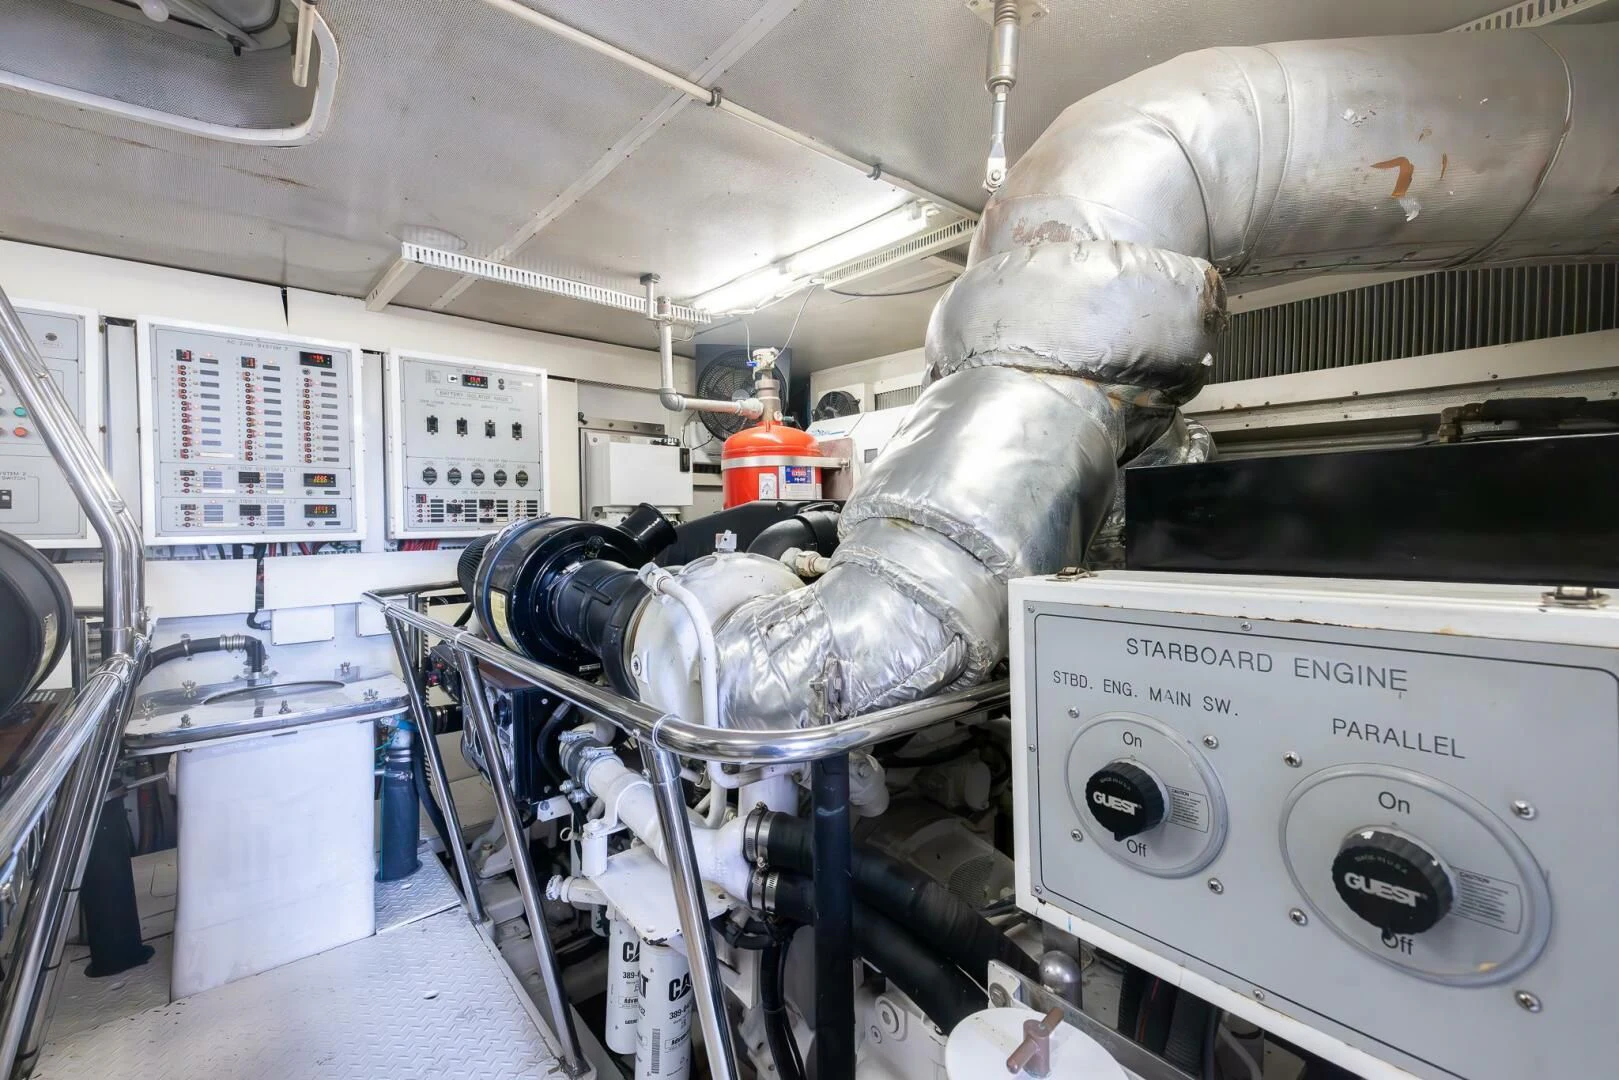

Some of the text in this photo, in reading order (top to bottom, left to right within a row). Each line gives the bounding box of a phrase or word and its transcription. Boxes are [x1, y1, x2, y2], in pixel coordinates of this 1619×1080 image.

[1126, 637, 1408, 692] STARBOARD ENGINE
[1053, 670, 1238, 716] STBD. ENG. MAIN SW.
[1122, 731, 1142, 748] On
[1332, 718, 1466, 759] PARALLEL
[1093, 791, 1138, 816] GUEST
[1378, 791, 1410, 814] On
[1126, 839, 1147, 857] Off
[1344, 872, 1421, 908] GUEST
[1381, 928, 1414, 955] Off
